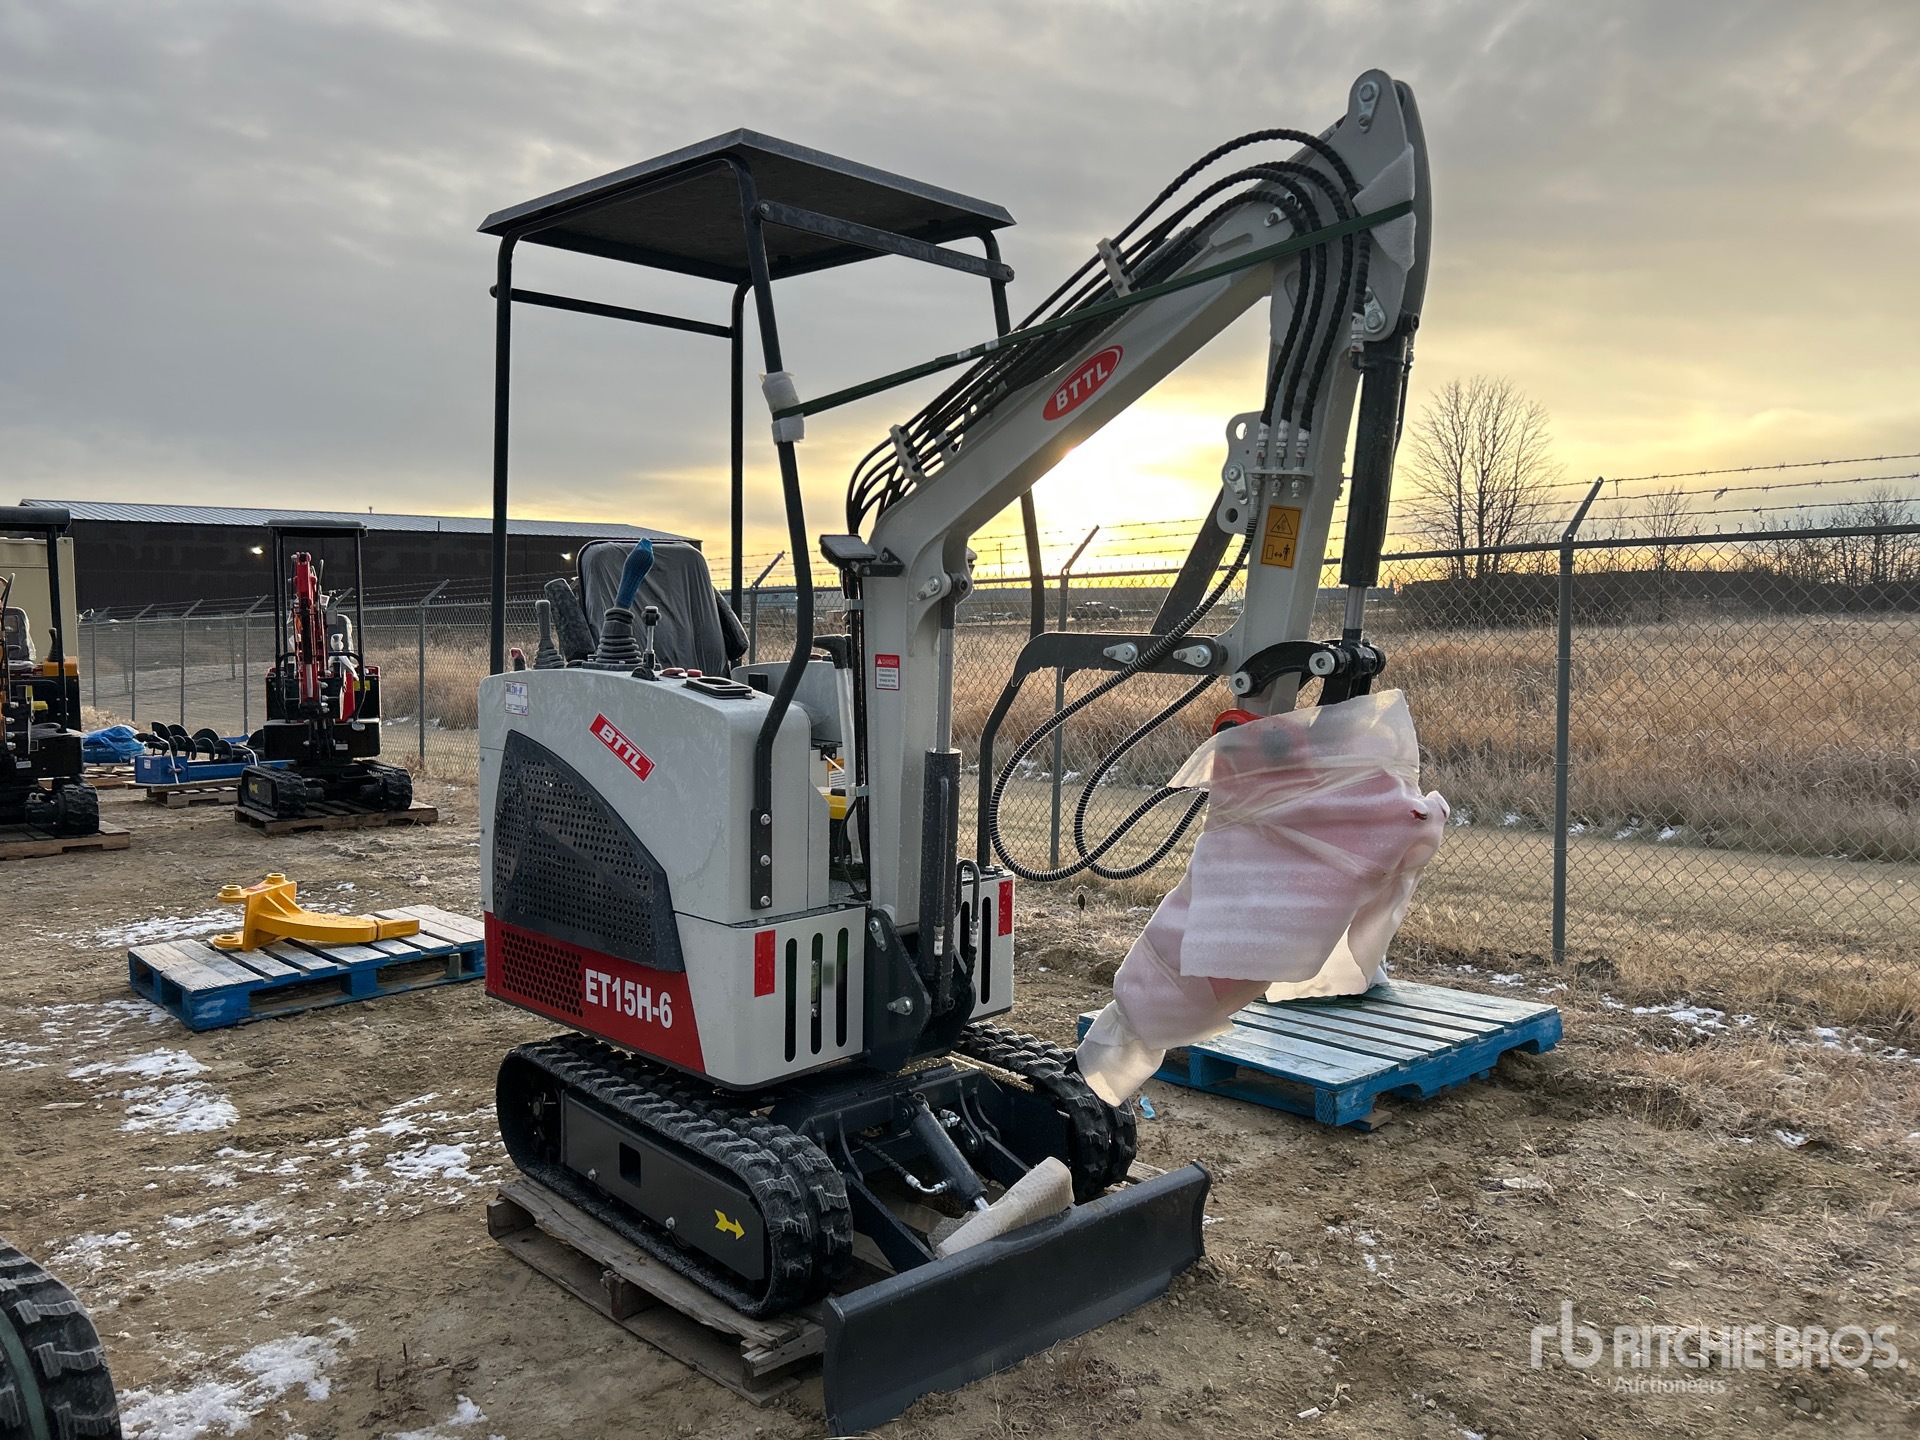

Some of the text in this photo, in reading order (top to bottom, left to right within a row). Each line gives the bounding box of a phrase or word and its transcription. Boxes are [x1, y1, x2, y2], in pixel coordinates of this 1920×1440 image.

[1055, 361, 1108, 412] BTTL
[599, 723, 642, 772] BTTL
[585, 968, 673, 1029] ET15H-6
